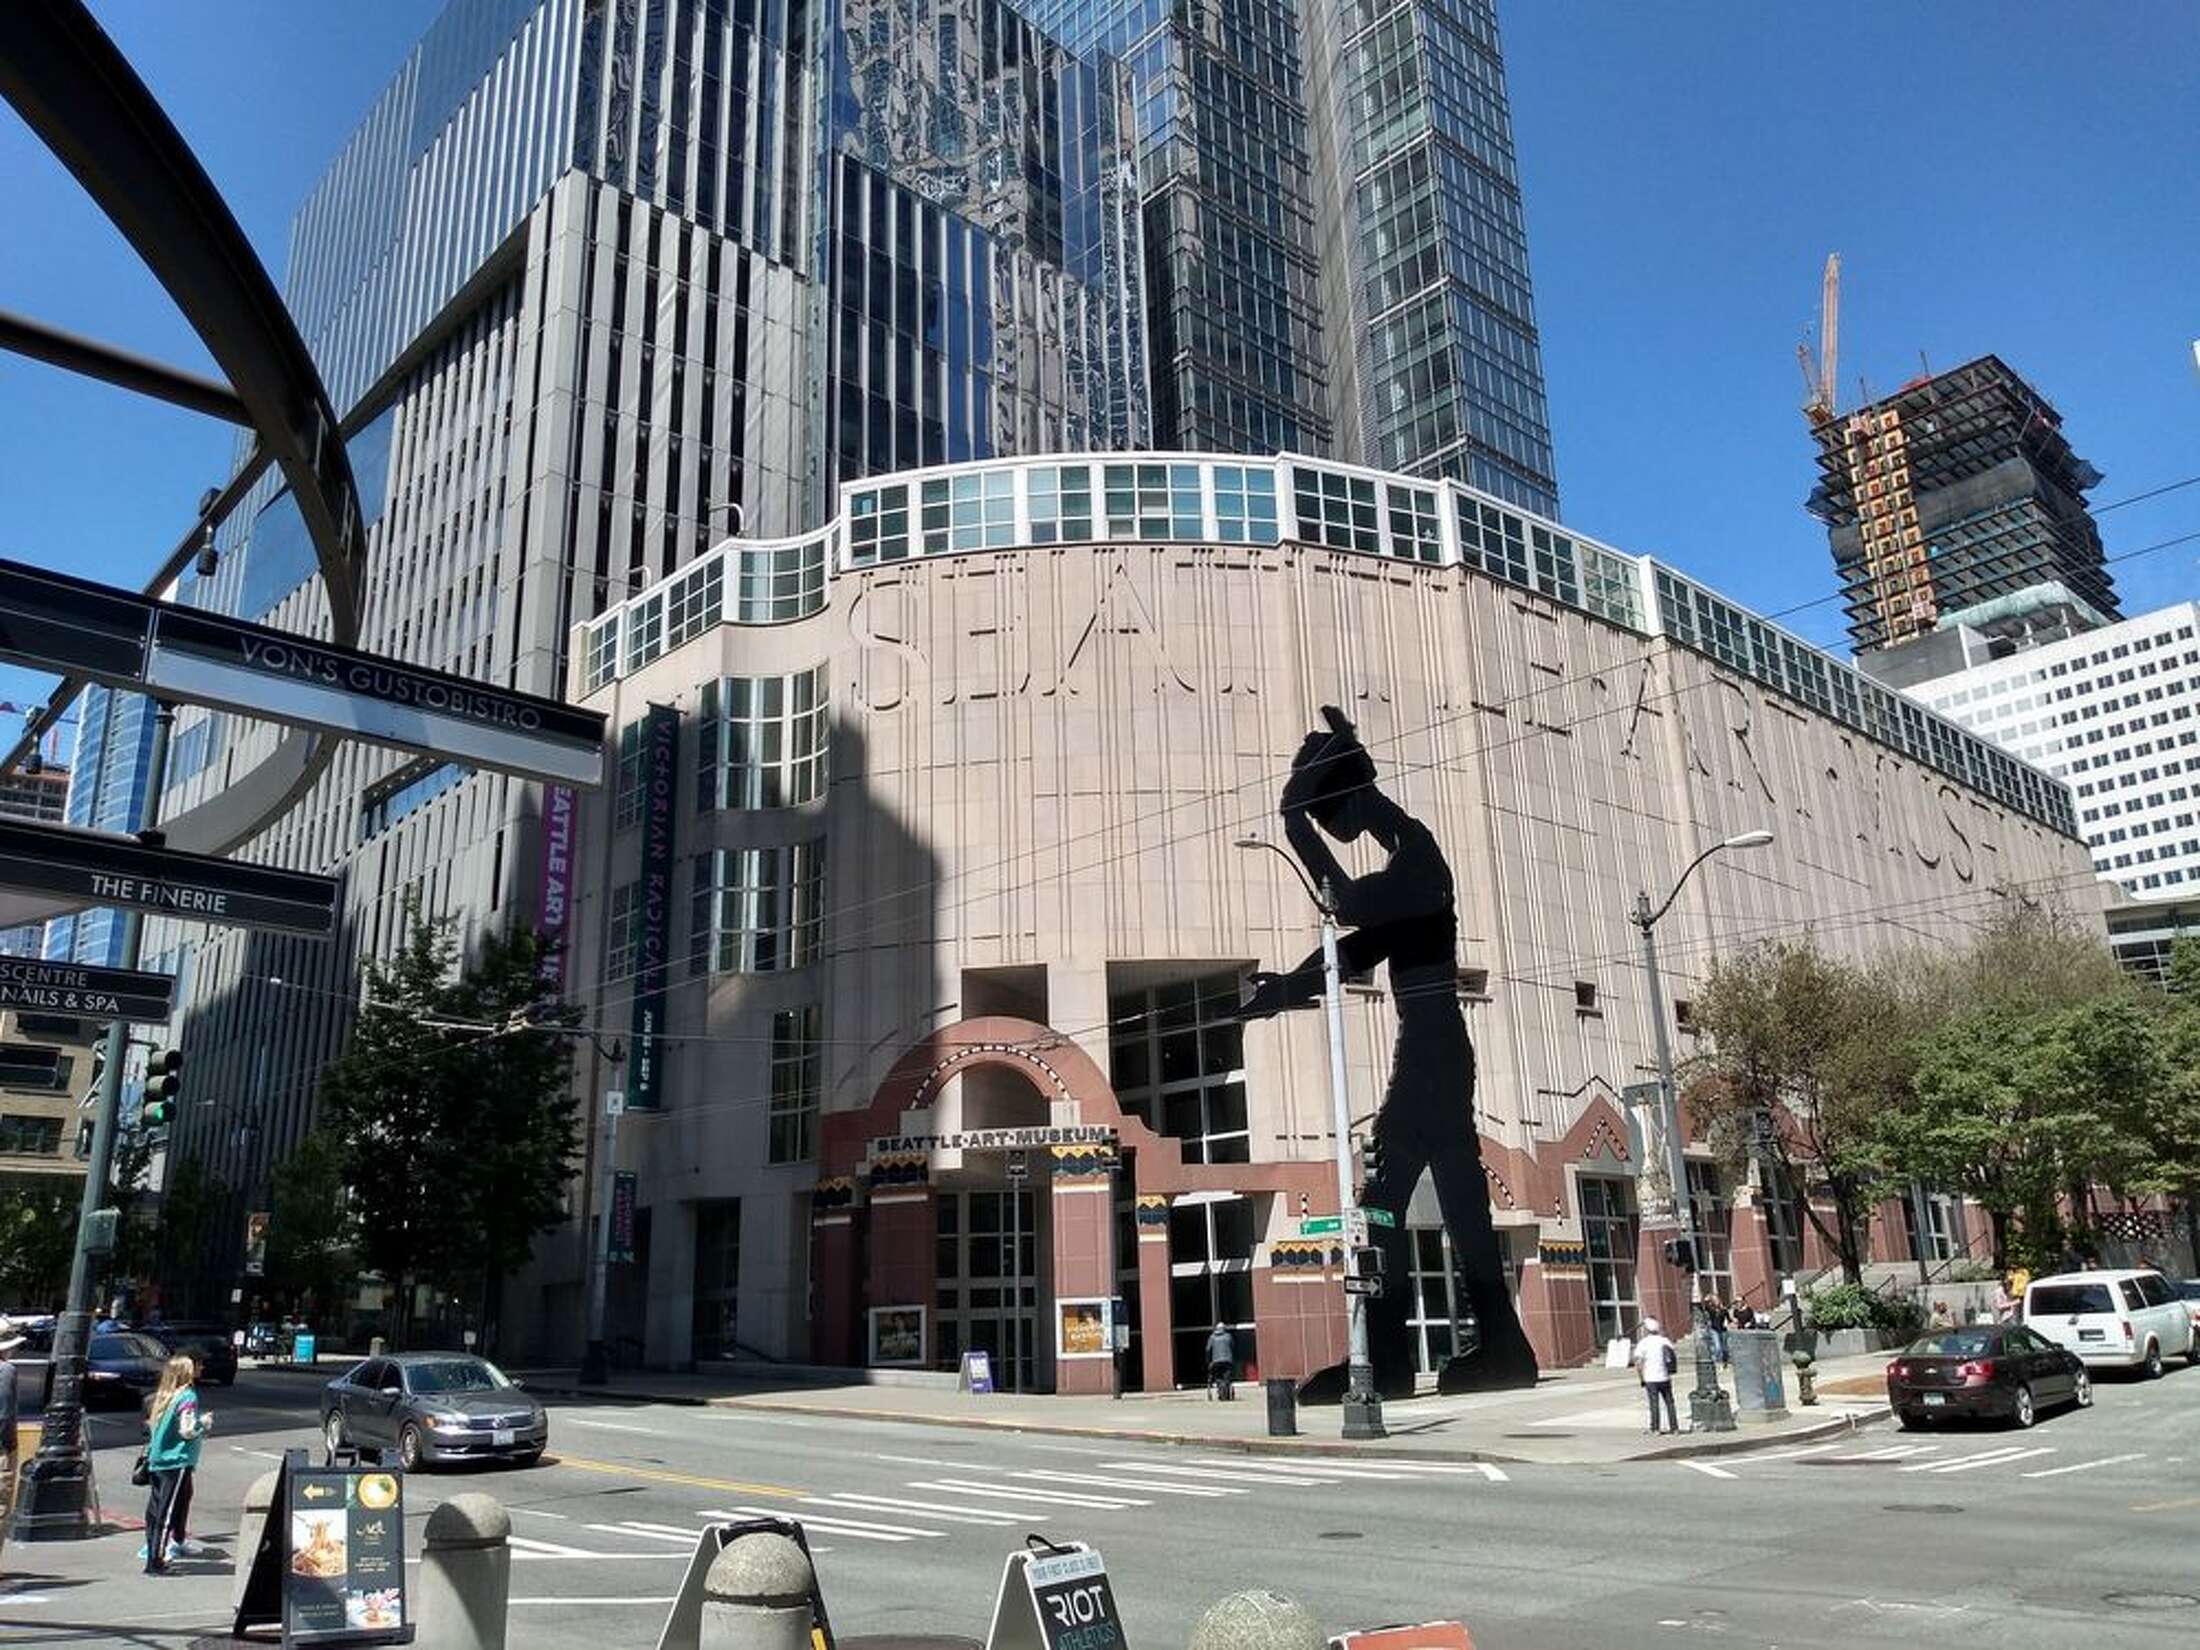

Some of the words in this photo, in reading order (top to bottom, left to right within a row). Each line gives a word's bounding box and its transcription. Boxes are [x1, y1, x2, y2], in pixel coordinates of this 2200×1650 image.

[240, 637, 338, 682] VON'S
[350, 666, 541, 731] GUSTOBISTRO
[648, 718, 673, 860] VICTORIAN
[548, 786, 572, 875] EATTLE
[91, 875, 134, 899] THE
[140, 882, 227, 913] FINERIE
[0, 963, 88, 987] SCENTRE
[1, 986, 59, 1006] NAILS
[65, 992, 78, 1008] &
[84, 994, 119, 1012] SPA
[878, 1136, 962, 1152] SEATTLE
[969, 1131, 1011, 1148] ART
[1015, 1126, 1109, 1146] MUSEUM
[1045, 1585, 1106, 1627] RIOT
